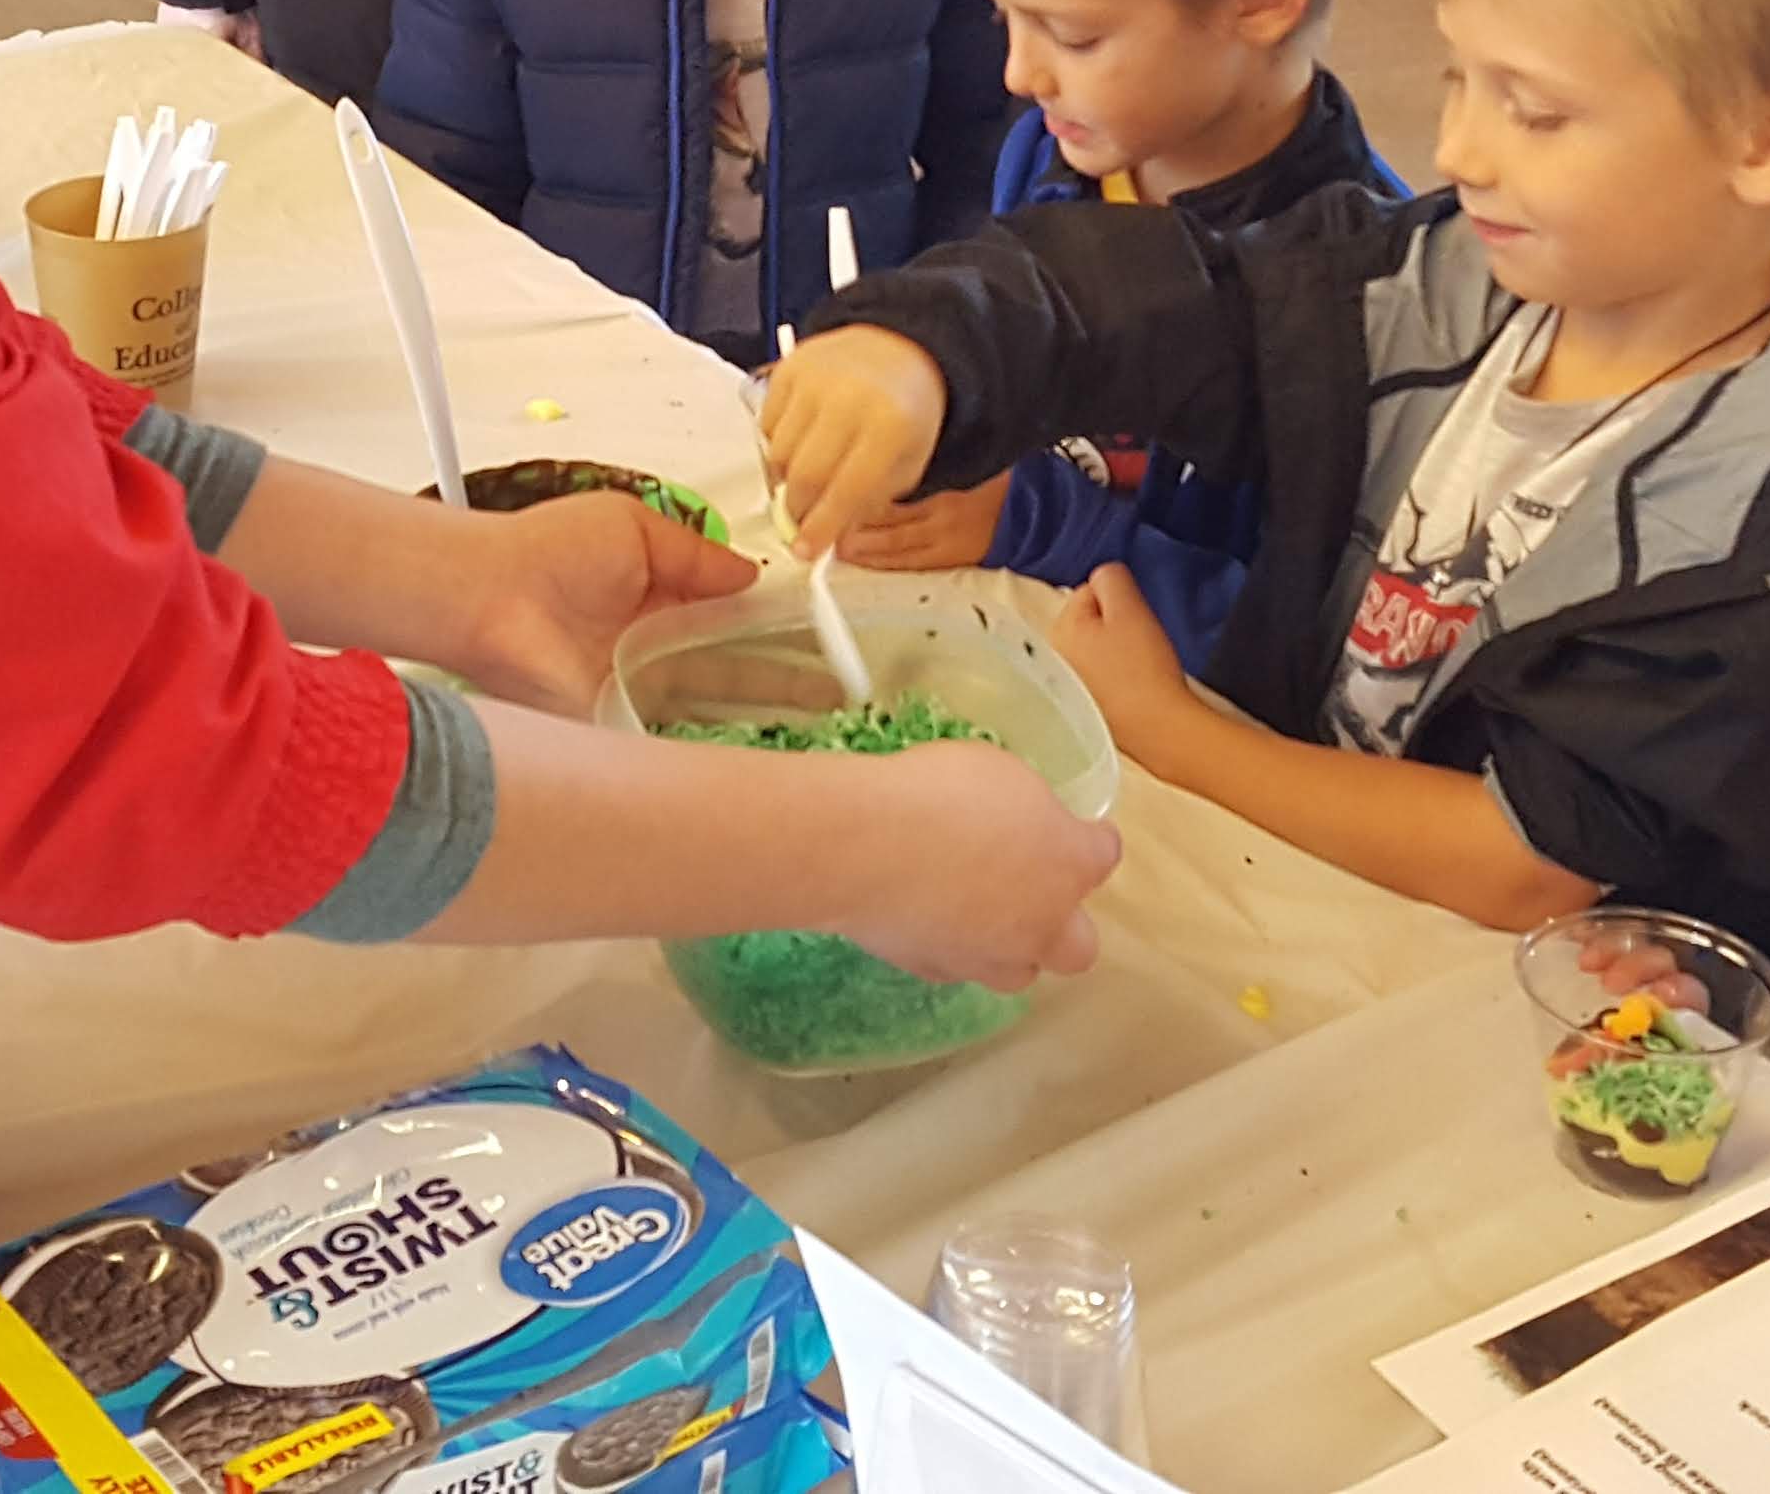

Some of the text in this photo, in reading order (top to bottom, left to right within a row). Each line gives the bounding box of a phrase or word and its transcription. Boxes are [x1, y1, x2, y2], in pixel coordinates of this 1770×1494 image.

[247, 1175, 464, 1299] SHOUT
[268, 1206, 498, 1331] TWIST &
[521, 1206, 623, 1265] Value
[535, 1206, 671, 1292] Great
[249, 1414, 381, 1478] RESEALABLE
